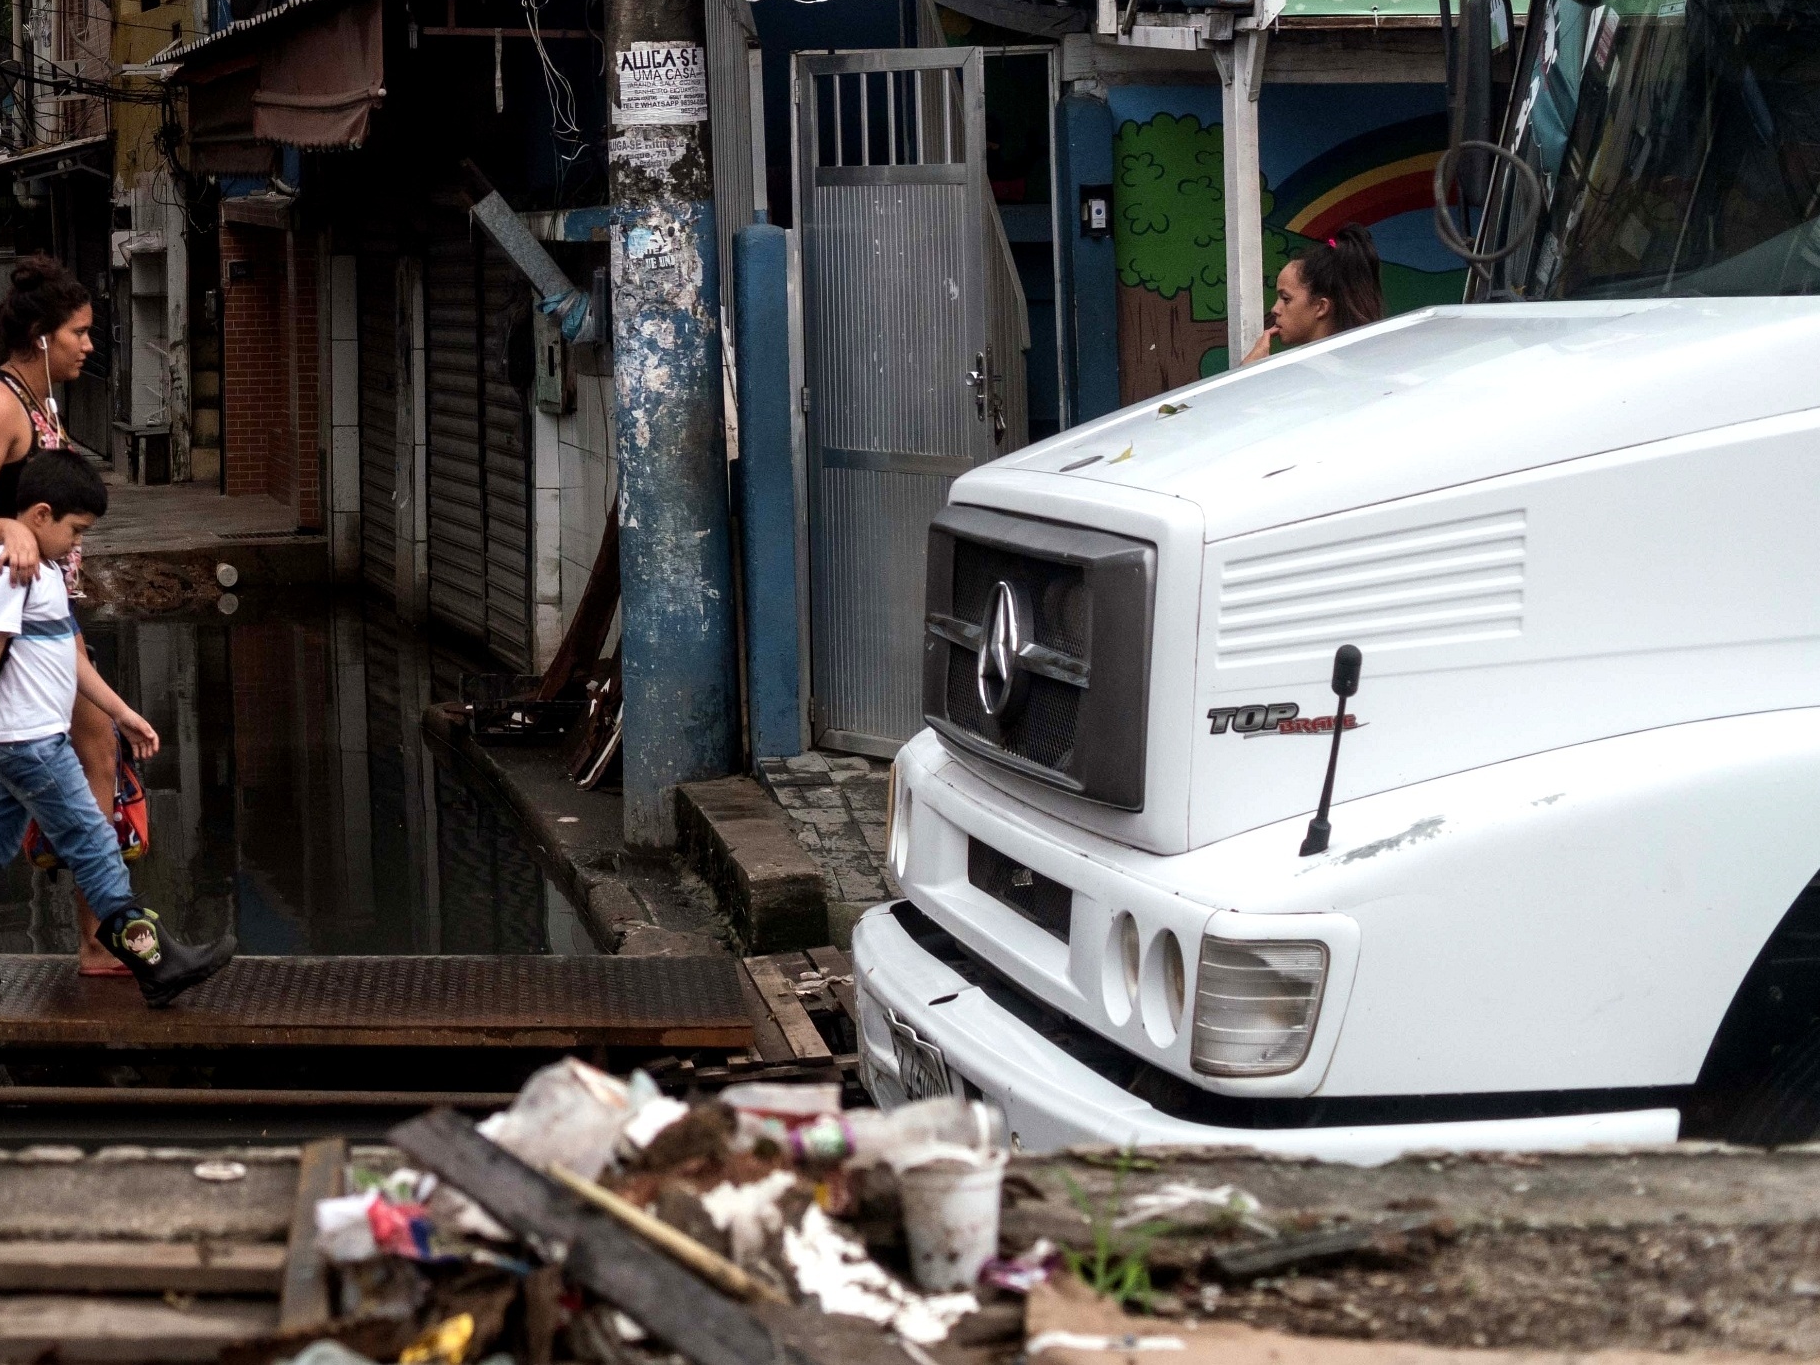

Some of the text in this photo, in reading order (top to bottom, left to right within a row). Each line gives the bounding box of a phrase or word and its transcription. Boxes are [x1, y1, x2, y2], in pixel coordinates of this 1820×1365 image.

[632, 67, 697, 82] UMA CASA
[1207, 702, 1299, 735] TOP
